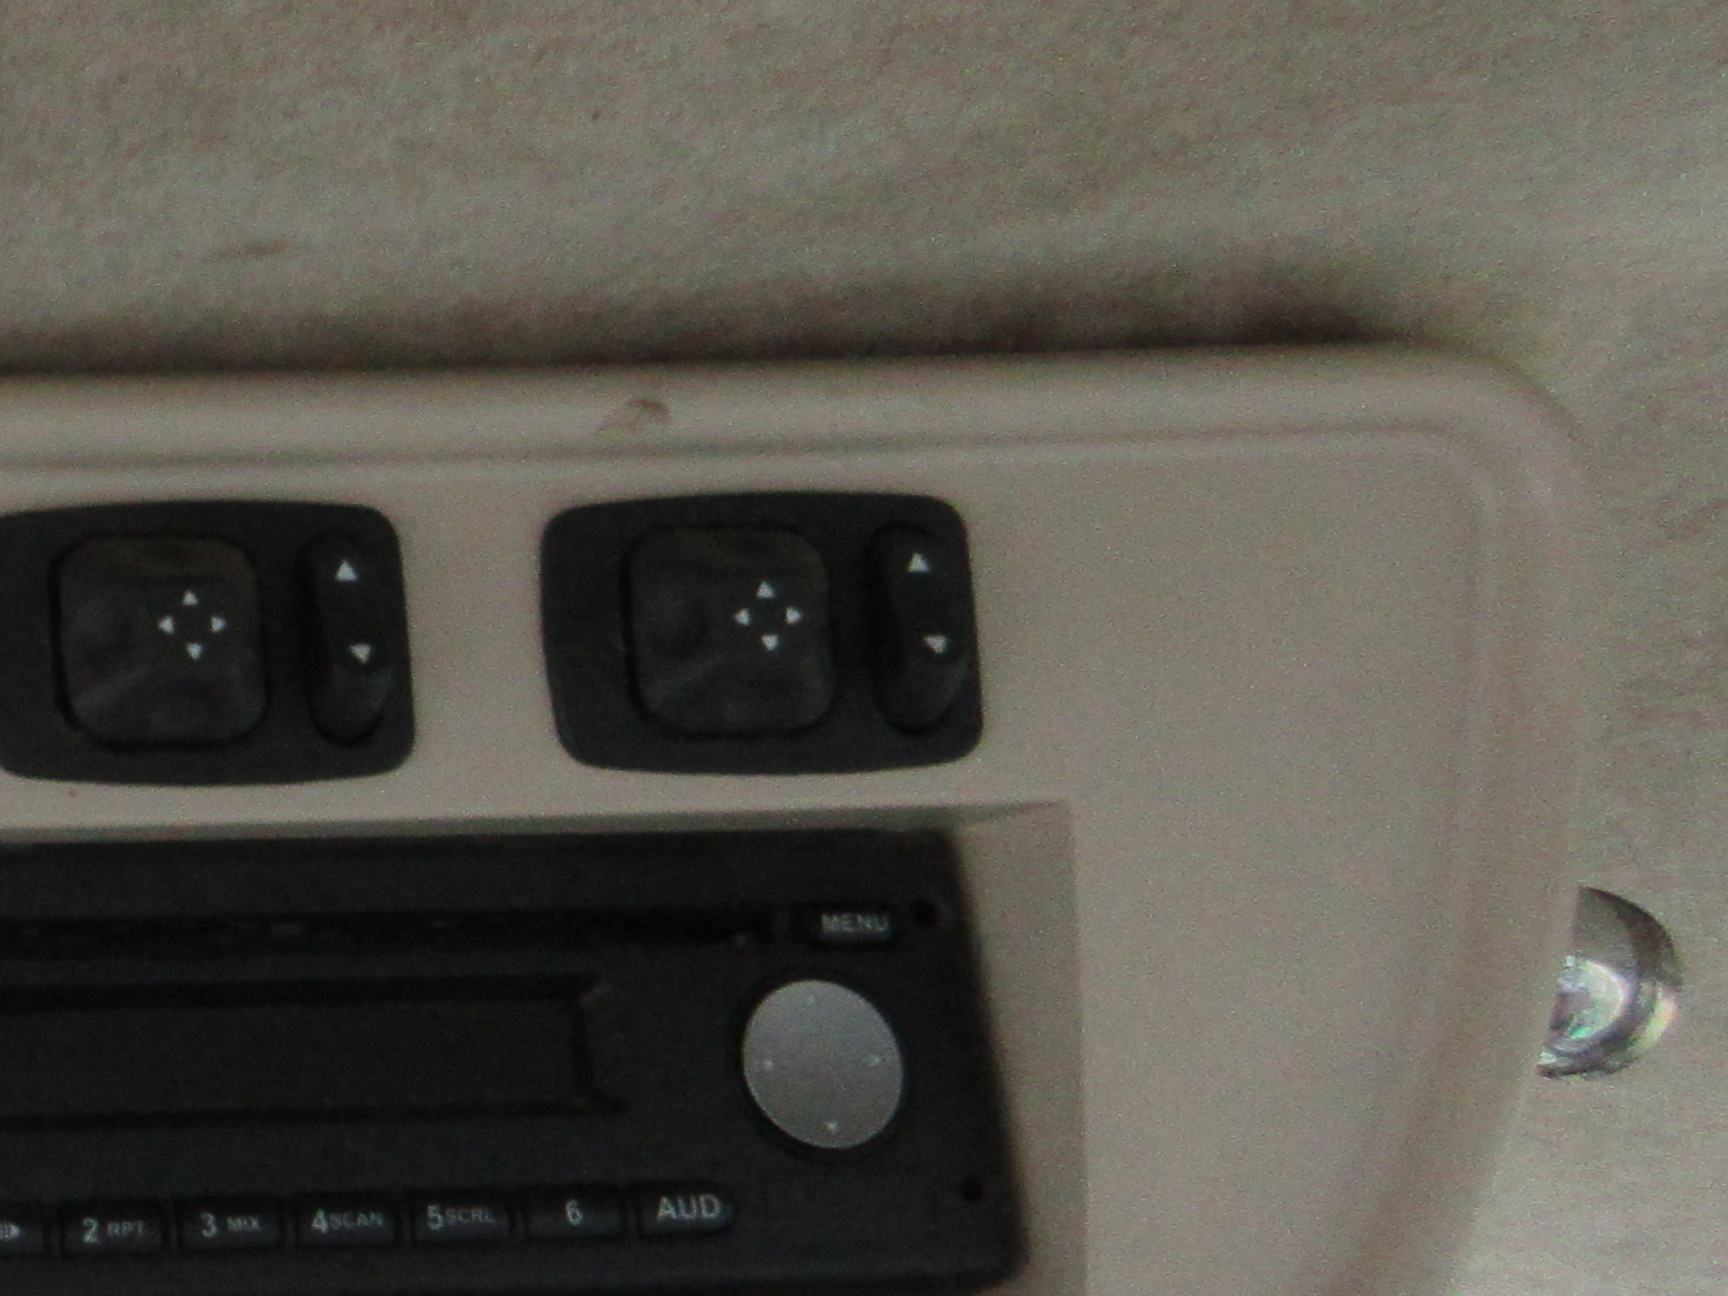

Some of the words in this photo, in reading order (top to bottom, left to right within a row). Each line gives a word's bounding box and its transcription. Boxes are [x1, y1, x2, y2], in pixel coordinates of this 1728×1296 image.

[820, 912, 889, 933] MENU
[311, 1208, 329, 1235] 4
[427, 1203, 444, 1232] 5
[564, 1199, 582, 1226] 6
[656, 1193, 722, 1223] AUD
[82, 1217, 100, 1244] 2
[107, 1220, 146, 1237] RPT
[200, 1212, 217, 1239] 3
[226, 1214, 262, 1233] MIX
